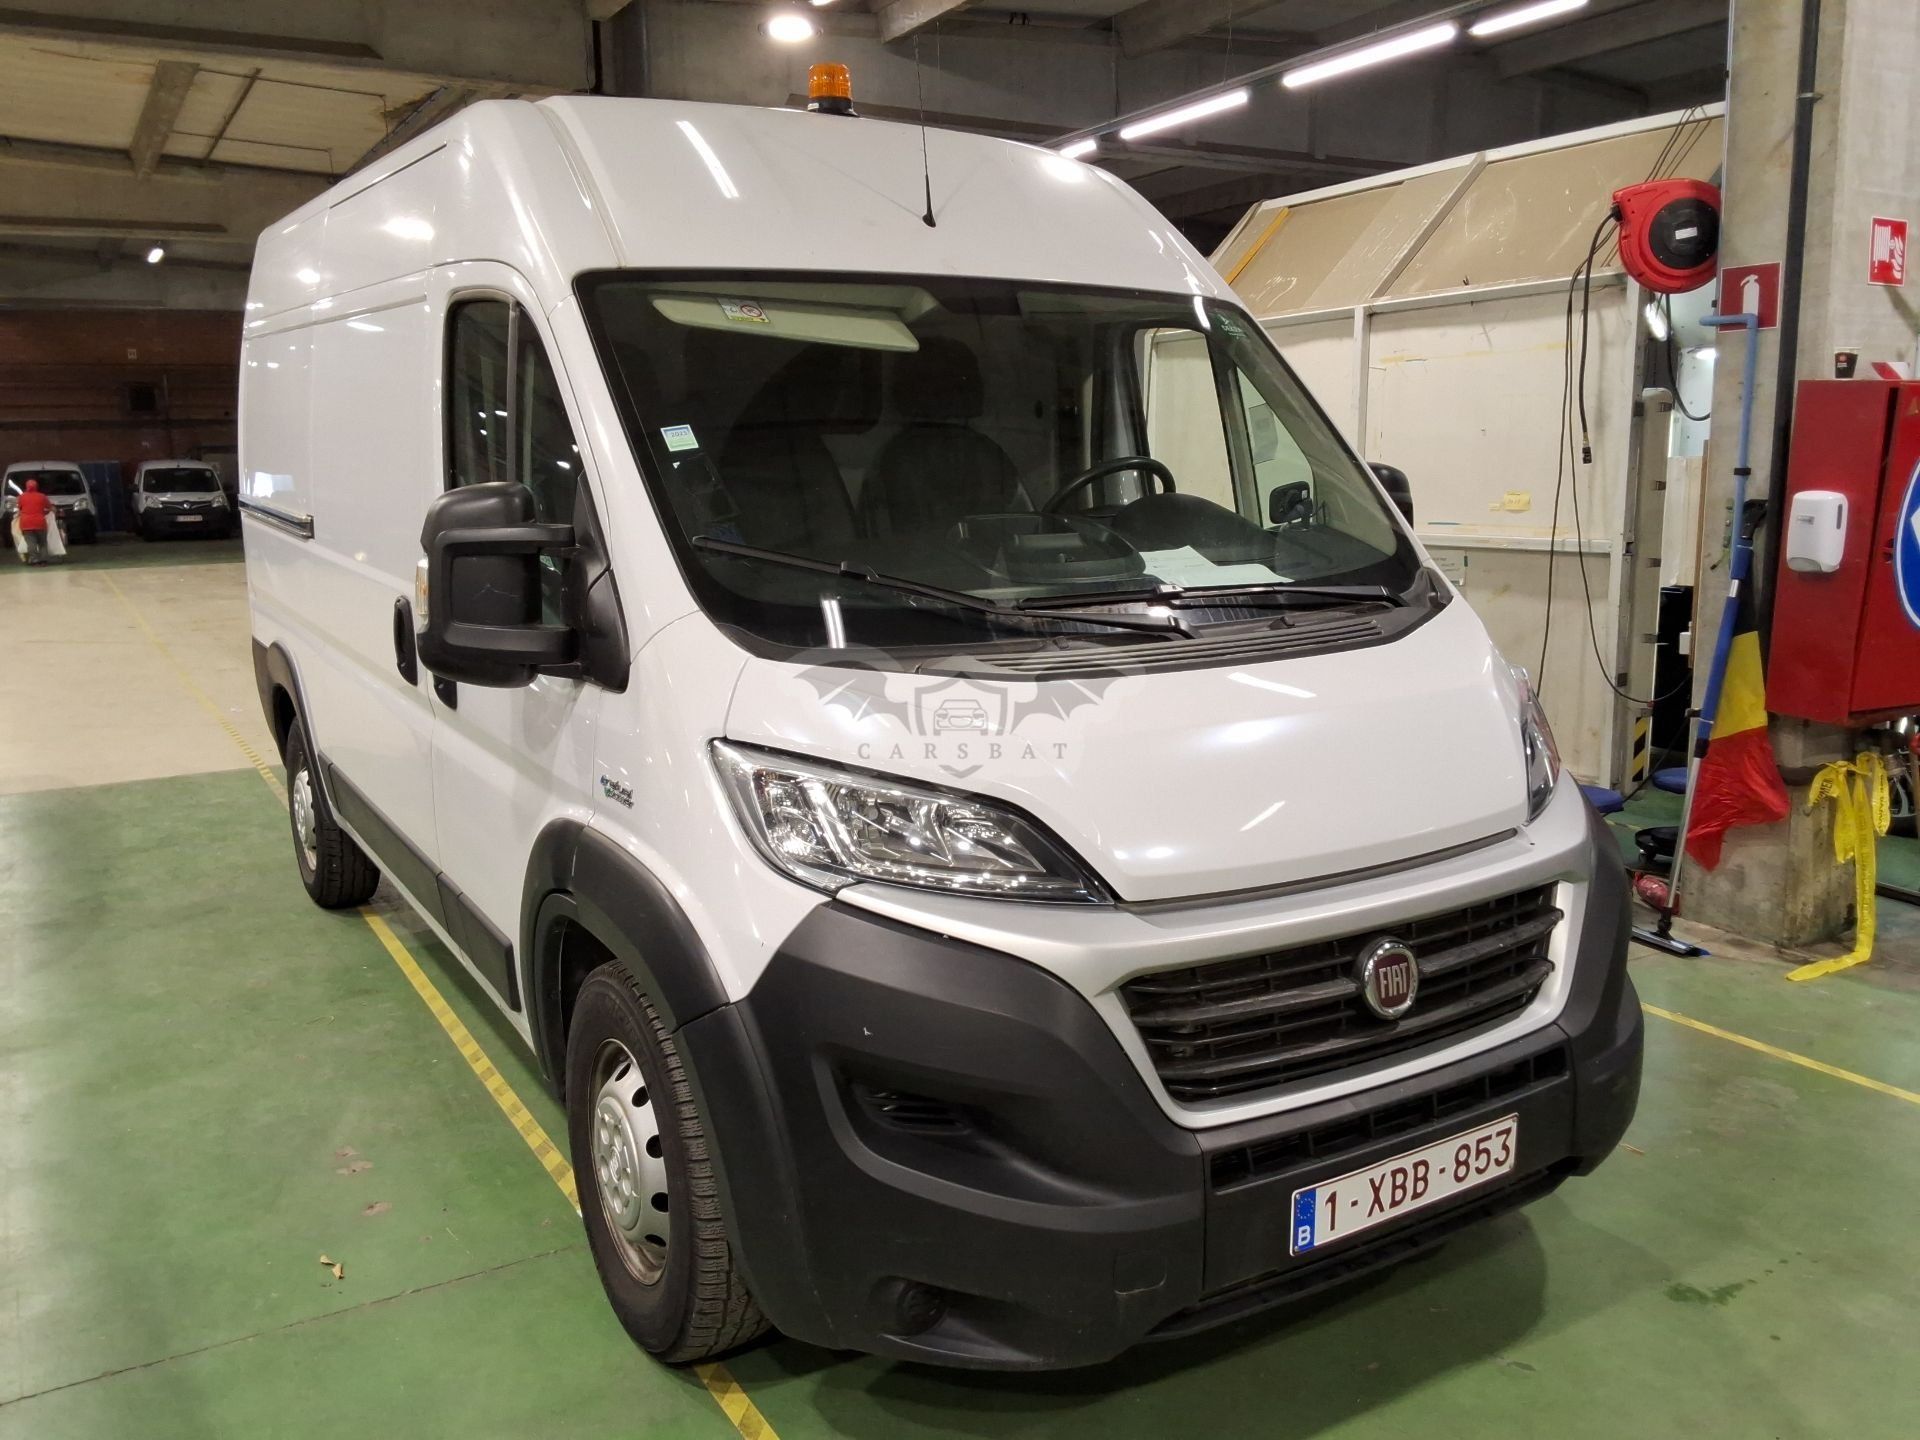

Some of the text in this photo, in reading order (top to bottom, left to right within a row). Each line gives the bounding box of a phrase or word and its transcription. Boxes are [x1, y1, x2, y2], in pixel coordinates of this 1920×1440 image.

[1379, 961, 1408, 999] FIAT
[1324, 1126, 1513, 1232] 1-XBB-853
[1297, 1225, 1311, 1247] B
